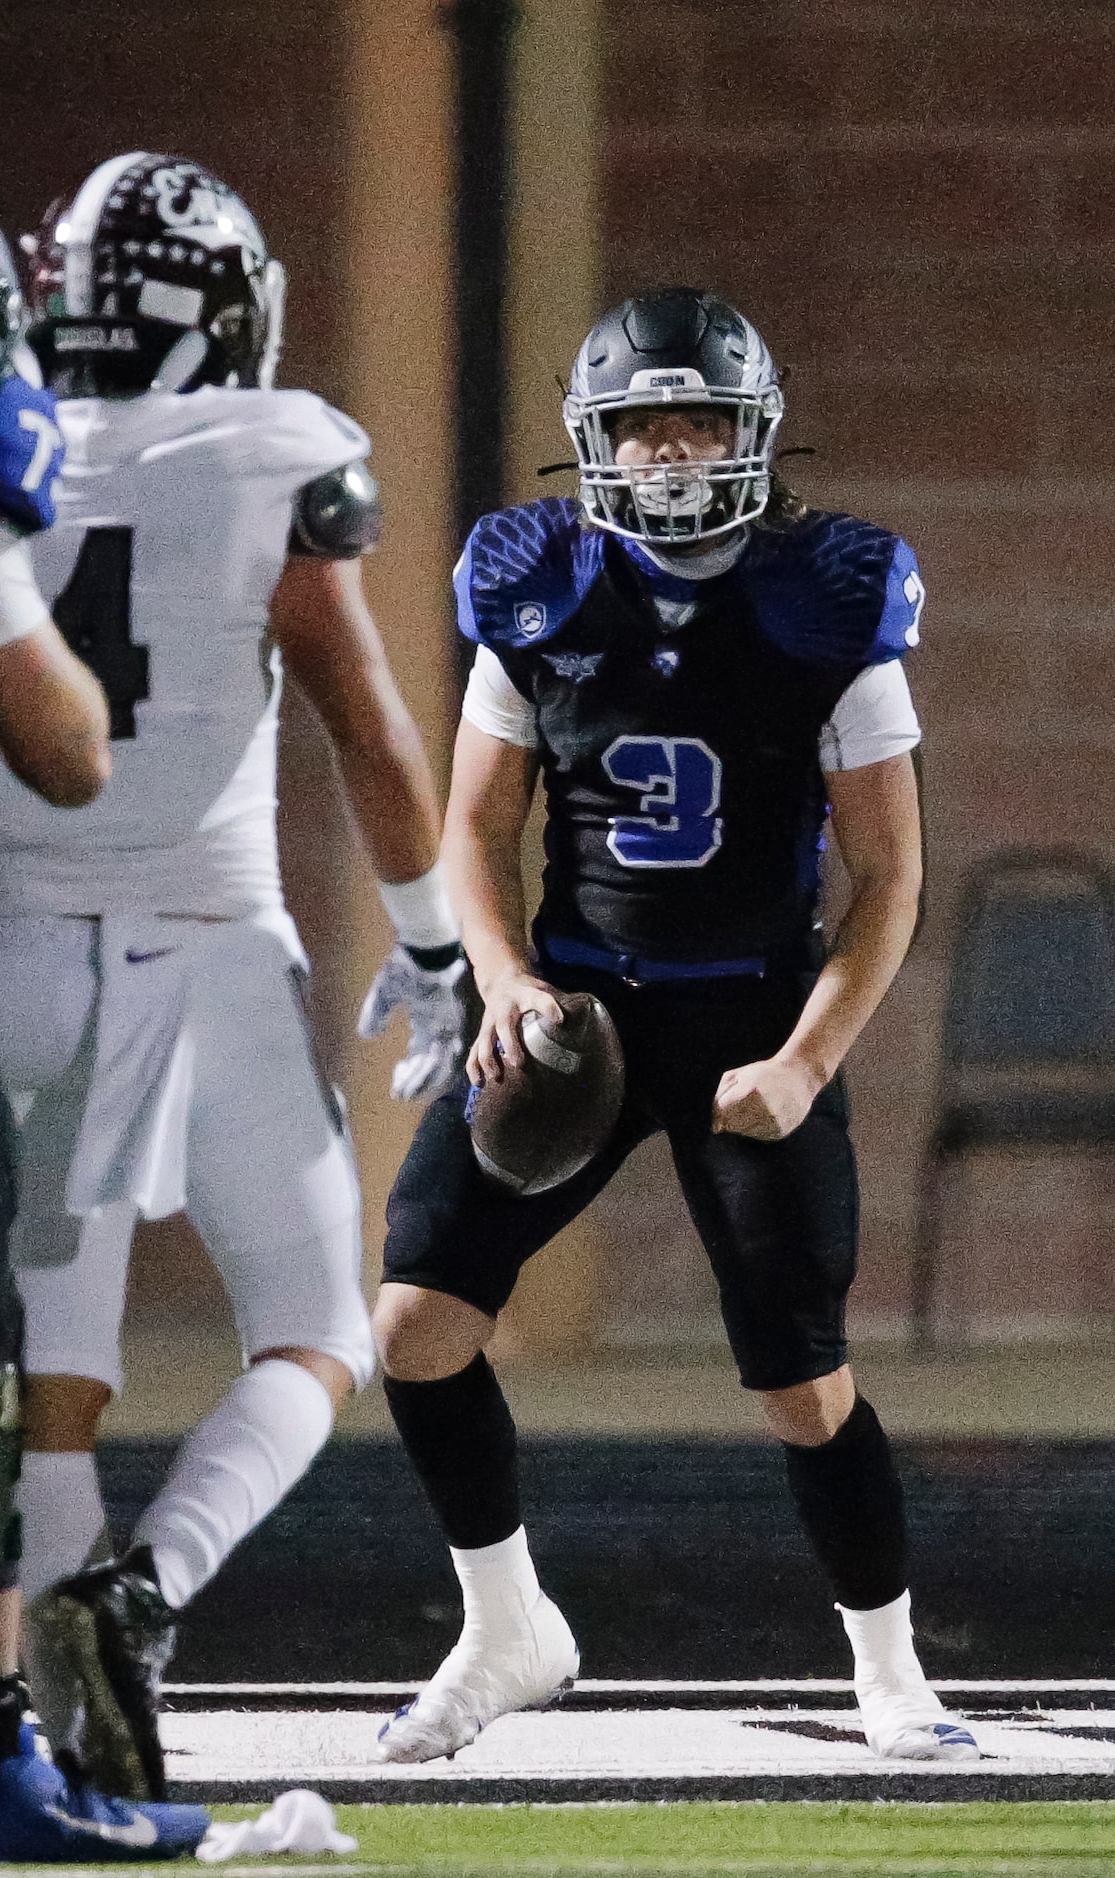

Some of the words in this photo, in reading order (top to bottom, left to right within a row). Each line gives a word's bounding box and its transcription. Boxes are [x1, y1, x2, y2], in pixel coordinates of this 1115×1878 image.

[17, 408, 64, 501] 7
[51, 525, 151, 740] 4
[600, 735, 723, 868] 3
